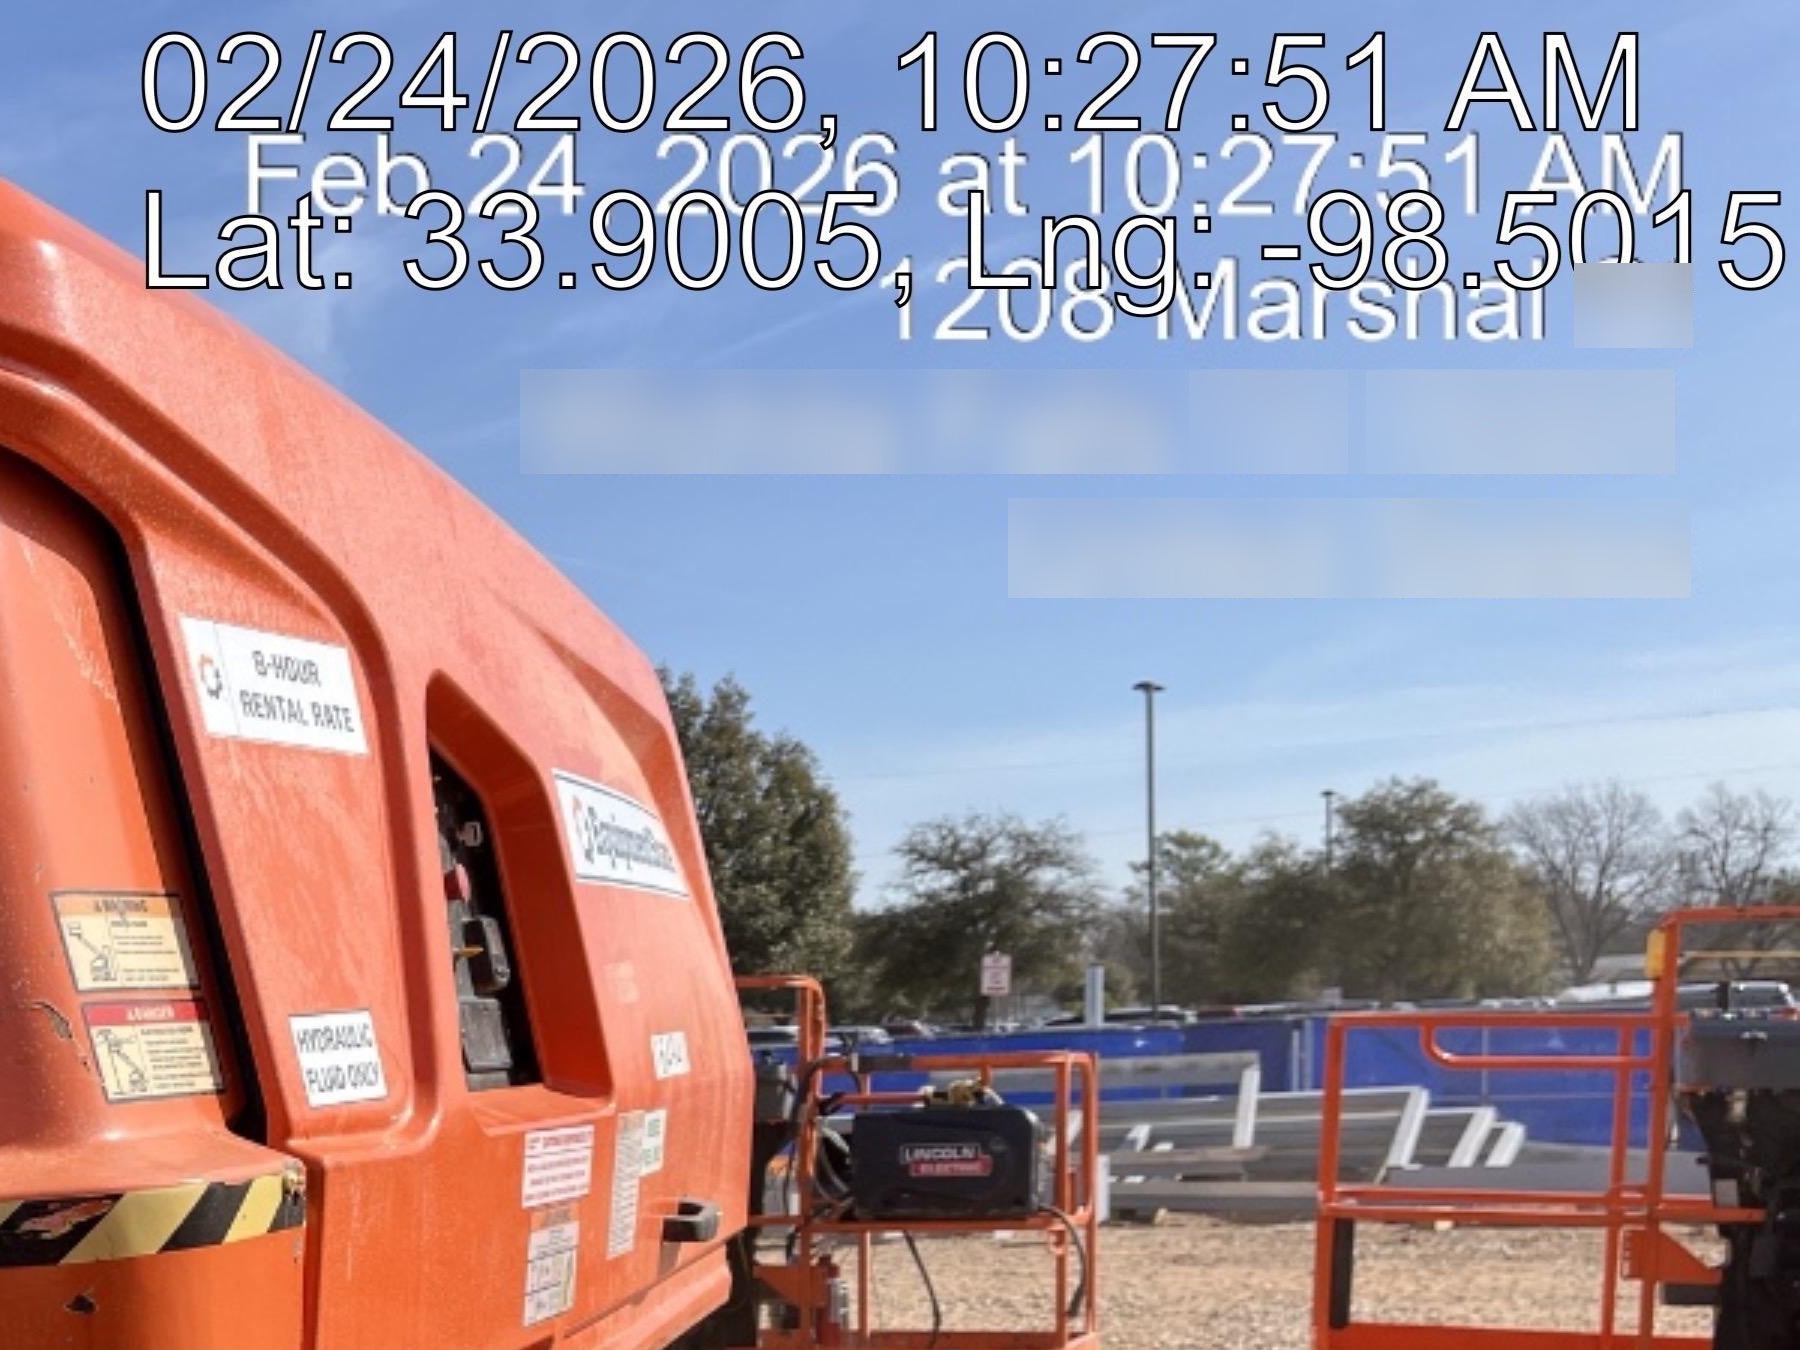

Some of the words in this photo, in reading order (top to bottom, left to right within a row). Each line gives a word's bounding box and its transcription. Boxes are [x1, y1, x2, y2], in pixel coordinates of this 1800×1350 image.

[252, 650, 321, 687] 8-HOUR
[240, 690, 309, 727] RENTAL
[311, 701, 355, 733] RATE
[297, 1023, 373, 1054] HYDRAULIC
[305, 1065, 347, 1094] FLUID
